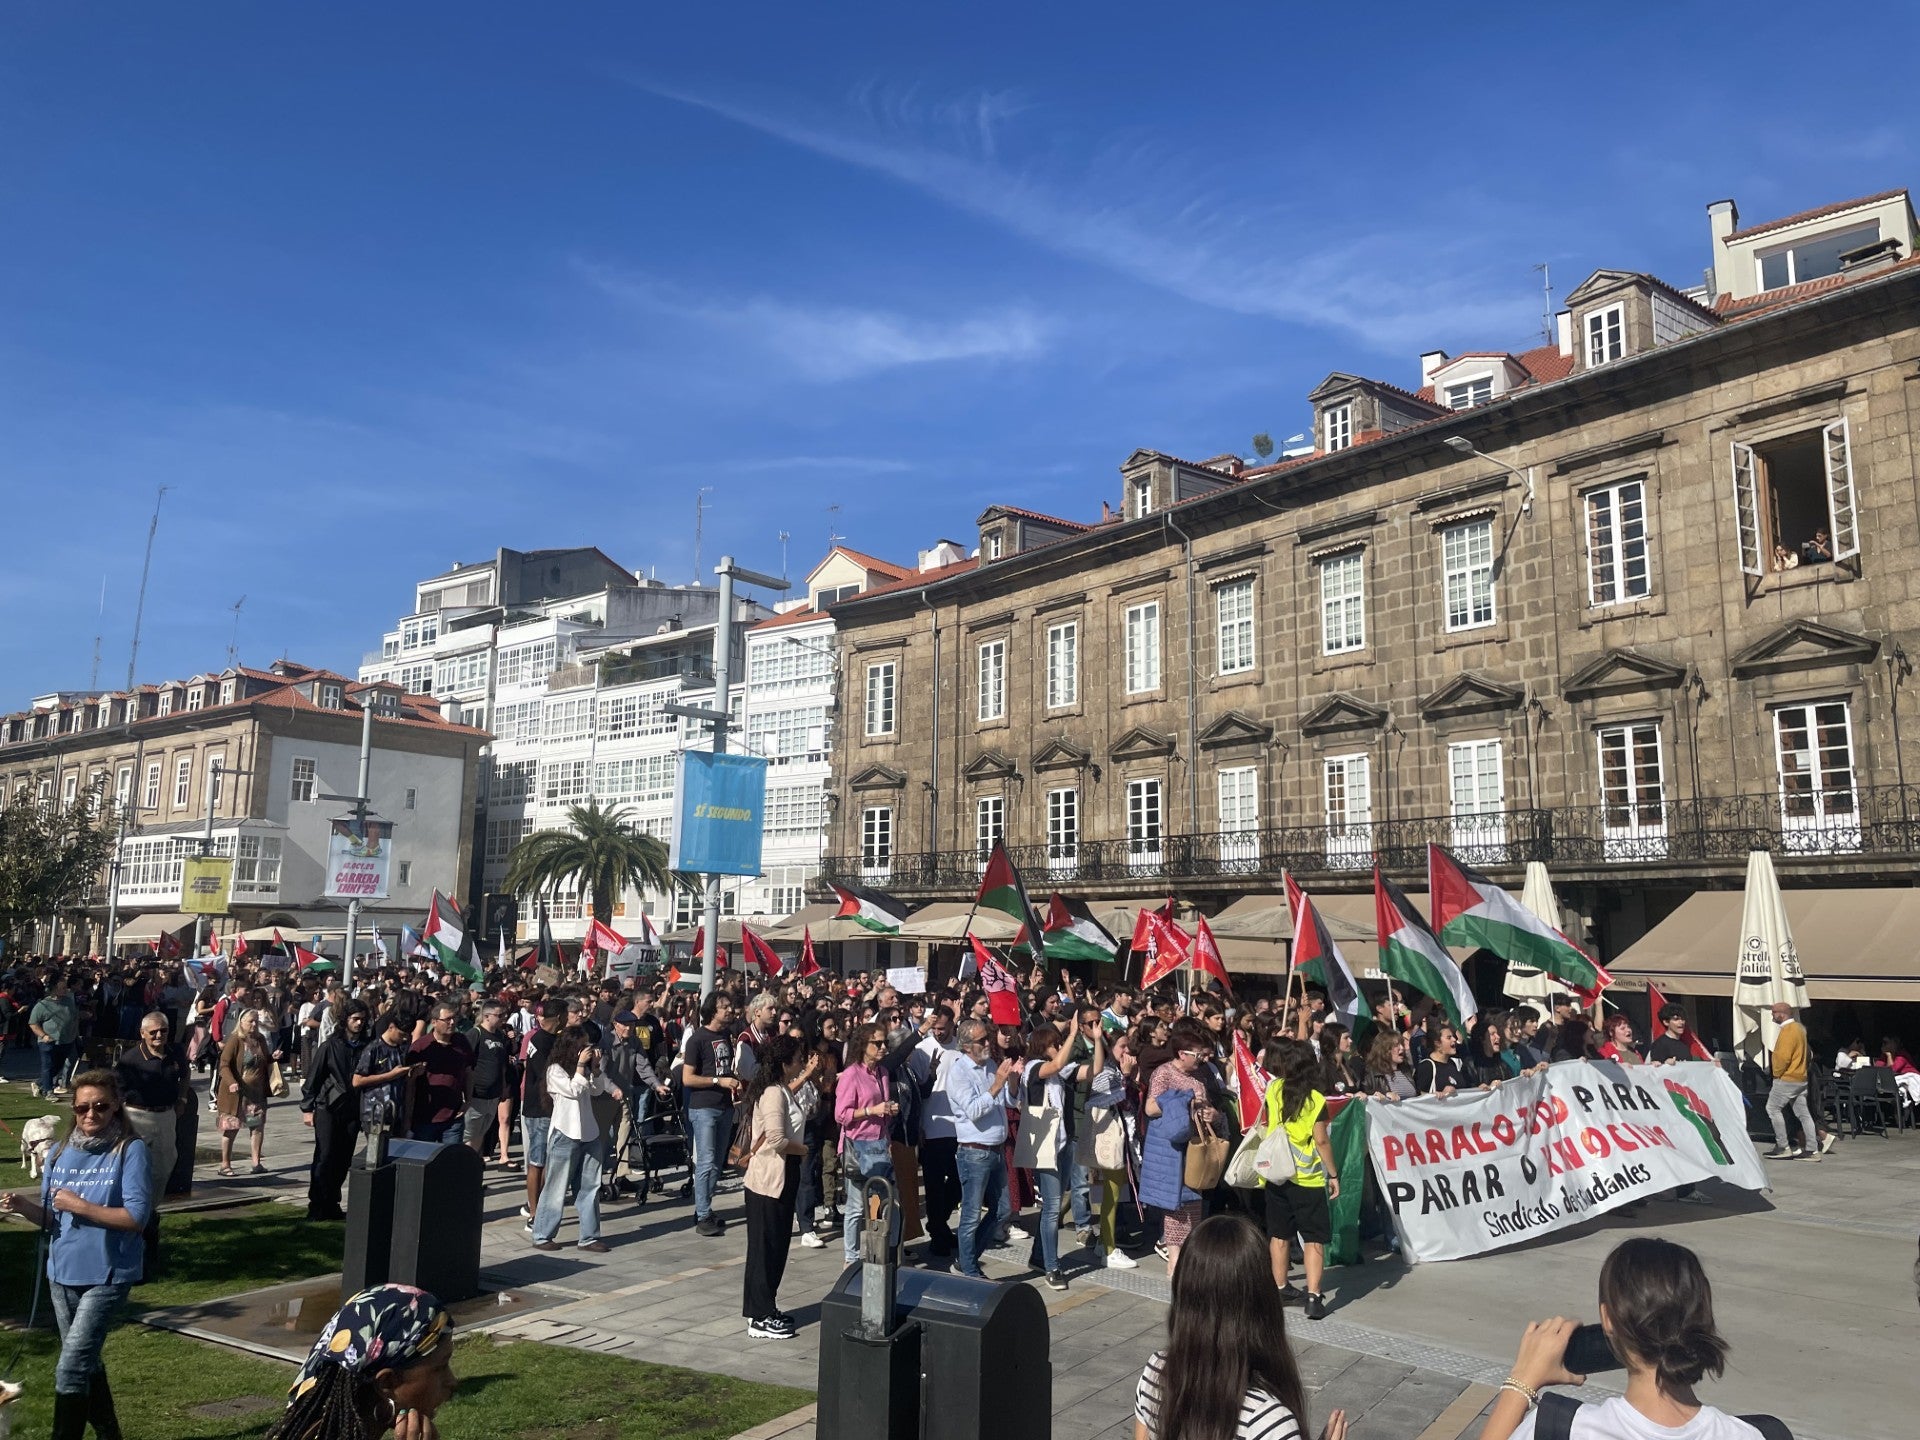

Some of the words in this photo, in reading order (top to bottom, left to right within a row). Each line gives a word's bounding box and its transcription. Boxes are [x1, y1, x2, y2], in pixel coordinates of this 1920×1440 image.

[335, 872, 380, 884] CARRERA
[1742, 951, 1770, 962] strell
[1572, 1083, 1661, 1112] PARA
[67, 1179, 114, 1187] memories
[1387, 1163, 1505, 1215] PARAR
[1520, 1154, 1537, 1185] O
